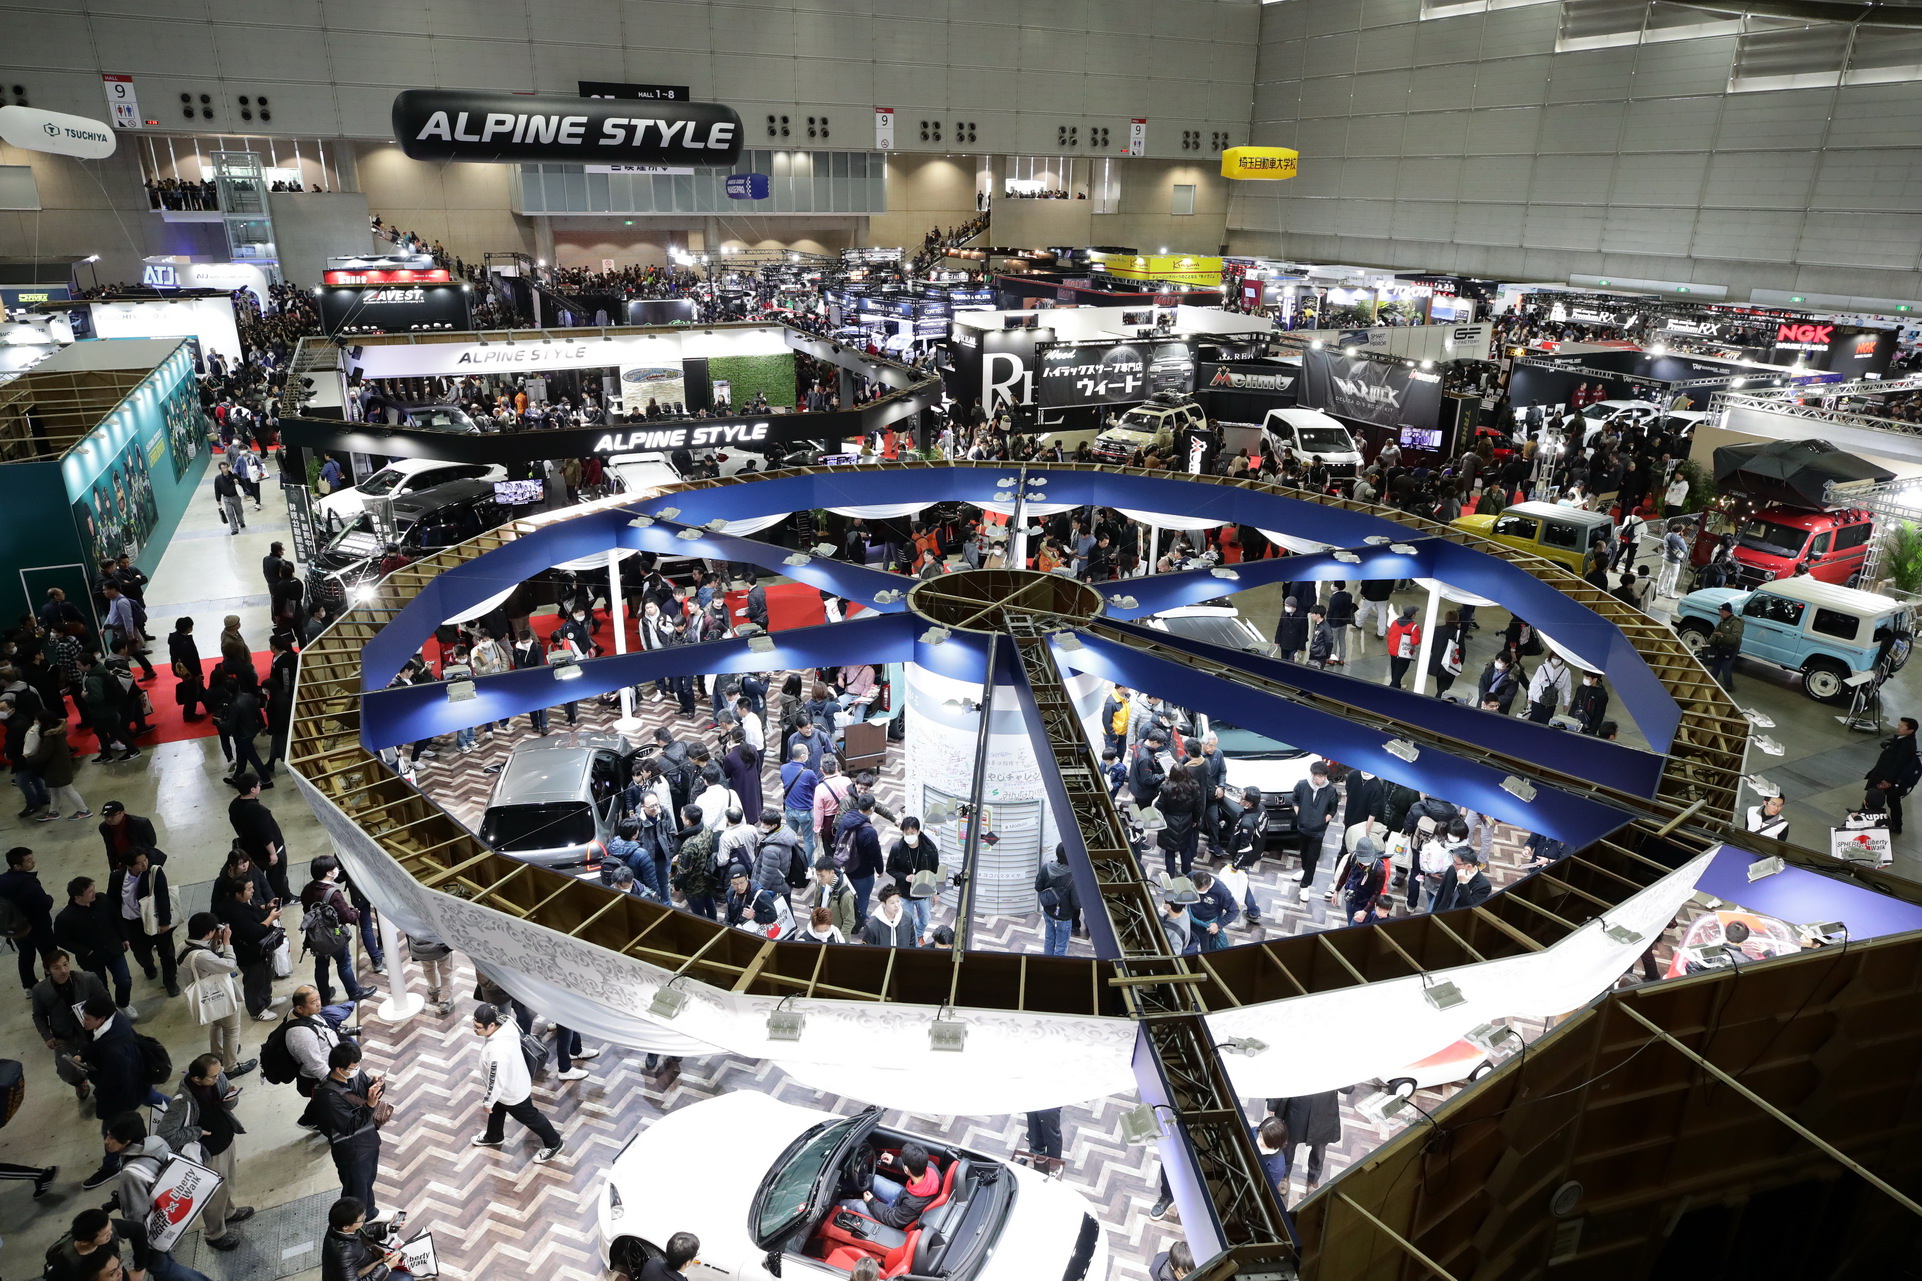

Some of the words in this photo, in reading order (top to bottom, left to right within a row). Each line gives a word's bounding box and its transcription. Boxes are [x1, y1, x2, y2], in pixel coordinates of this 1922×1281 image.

[115, 84, 126, 98] 9
[882, 115, 888, 126] 9
[64, 128, 108, 142] TSUCHIYA
[416, 110, 588, 145] ALPINE
[598, 117, 736, 150] STYLE
[1136, 125, 1141, 136] 9
[1239, 157, 1296, 170] 埼玉自動車大学校
[144, 265, 175, 285] ATJ
[1392, 285, 1432, 298] TOYOTA
[1666, 322, 1700, 333] Premium
[1700, 322, 1722, 336] RX
[1778, 324, 1834, 344] NGK
[458, 350, 525, 364] ALPINE
[531, 346, 586, 361] STYLE
[1856, 342, 1876, 354] NGK
[1042, 362, 1144, 378] ハイラックスサーフ専門店
[1076, 374, 1142, 397] ウィード
[1335, 396, 1354, 405] DELICA
[594, 428, 686, 452] ALPINE
[691, 422, 768, 445] STYLE
[169, 1168, 196, 1200] Liberty
[182, 1176, 201, 1200] Walk
[150, 1208, 168, 1230] HERE
[408, 1260, 428, 1270] Walk
